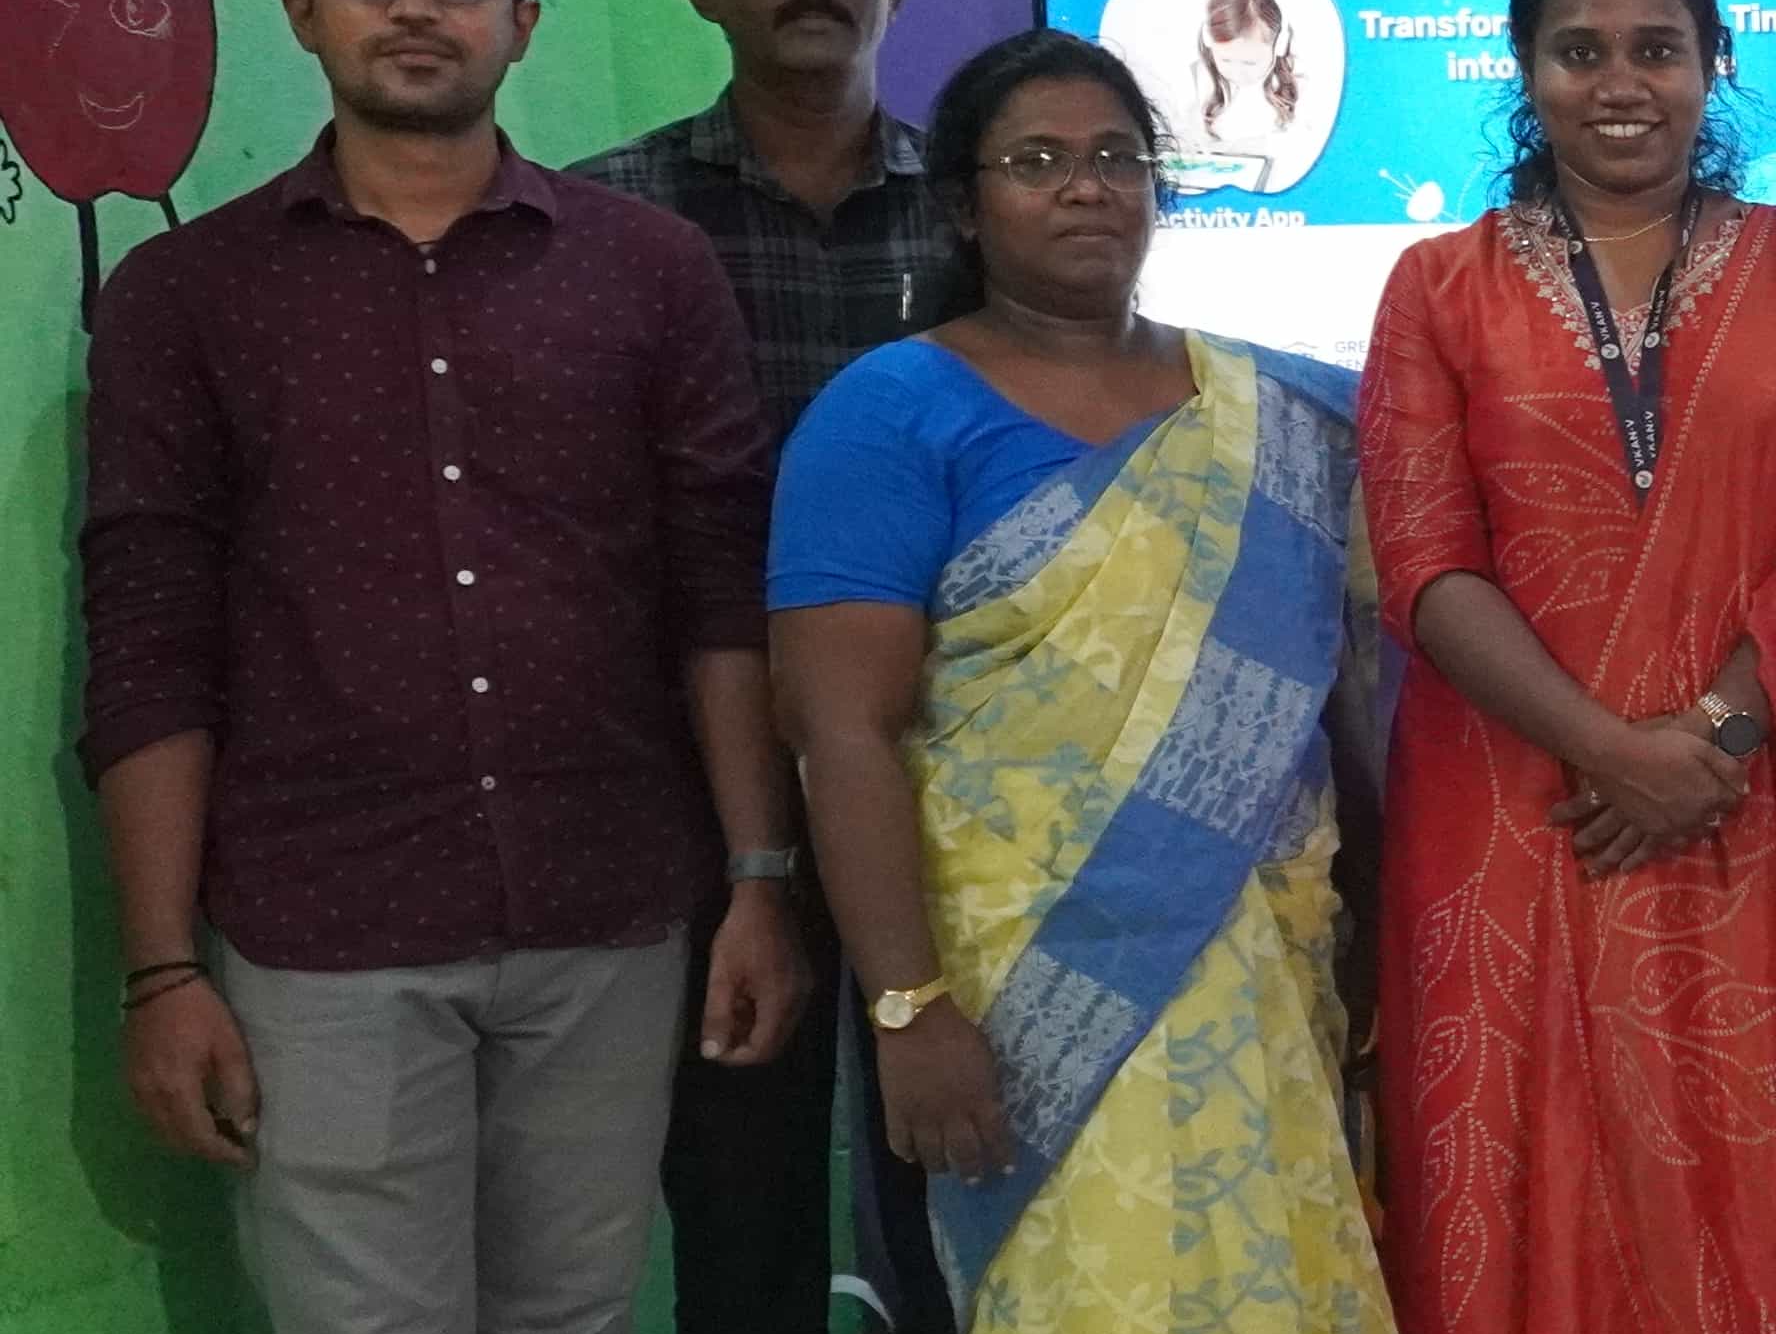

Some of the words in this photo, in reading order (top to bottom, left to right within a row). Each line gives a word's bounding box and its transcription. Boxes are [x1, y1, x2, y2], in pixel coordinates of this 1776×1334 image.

[1358, 9, 1511, 40] Transfor
[1446, 51, 1516, 81] into
[1334, 339, 1368, 353] GRE
